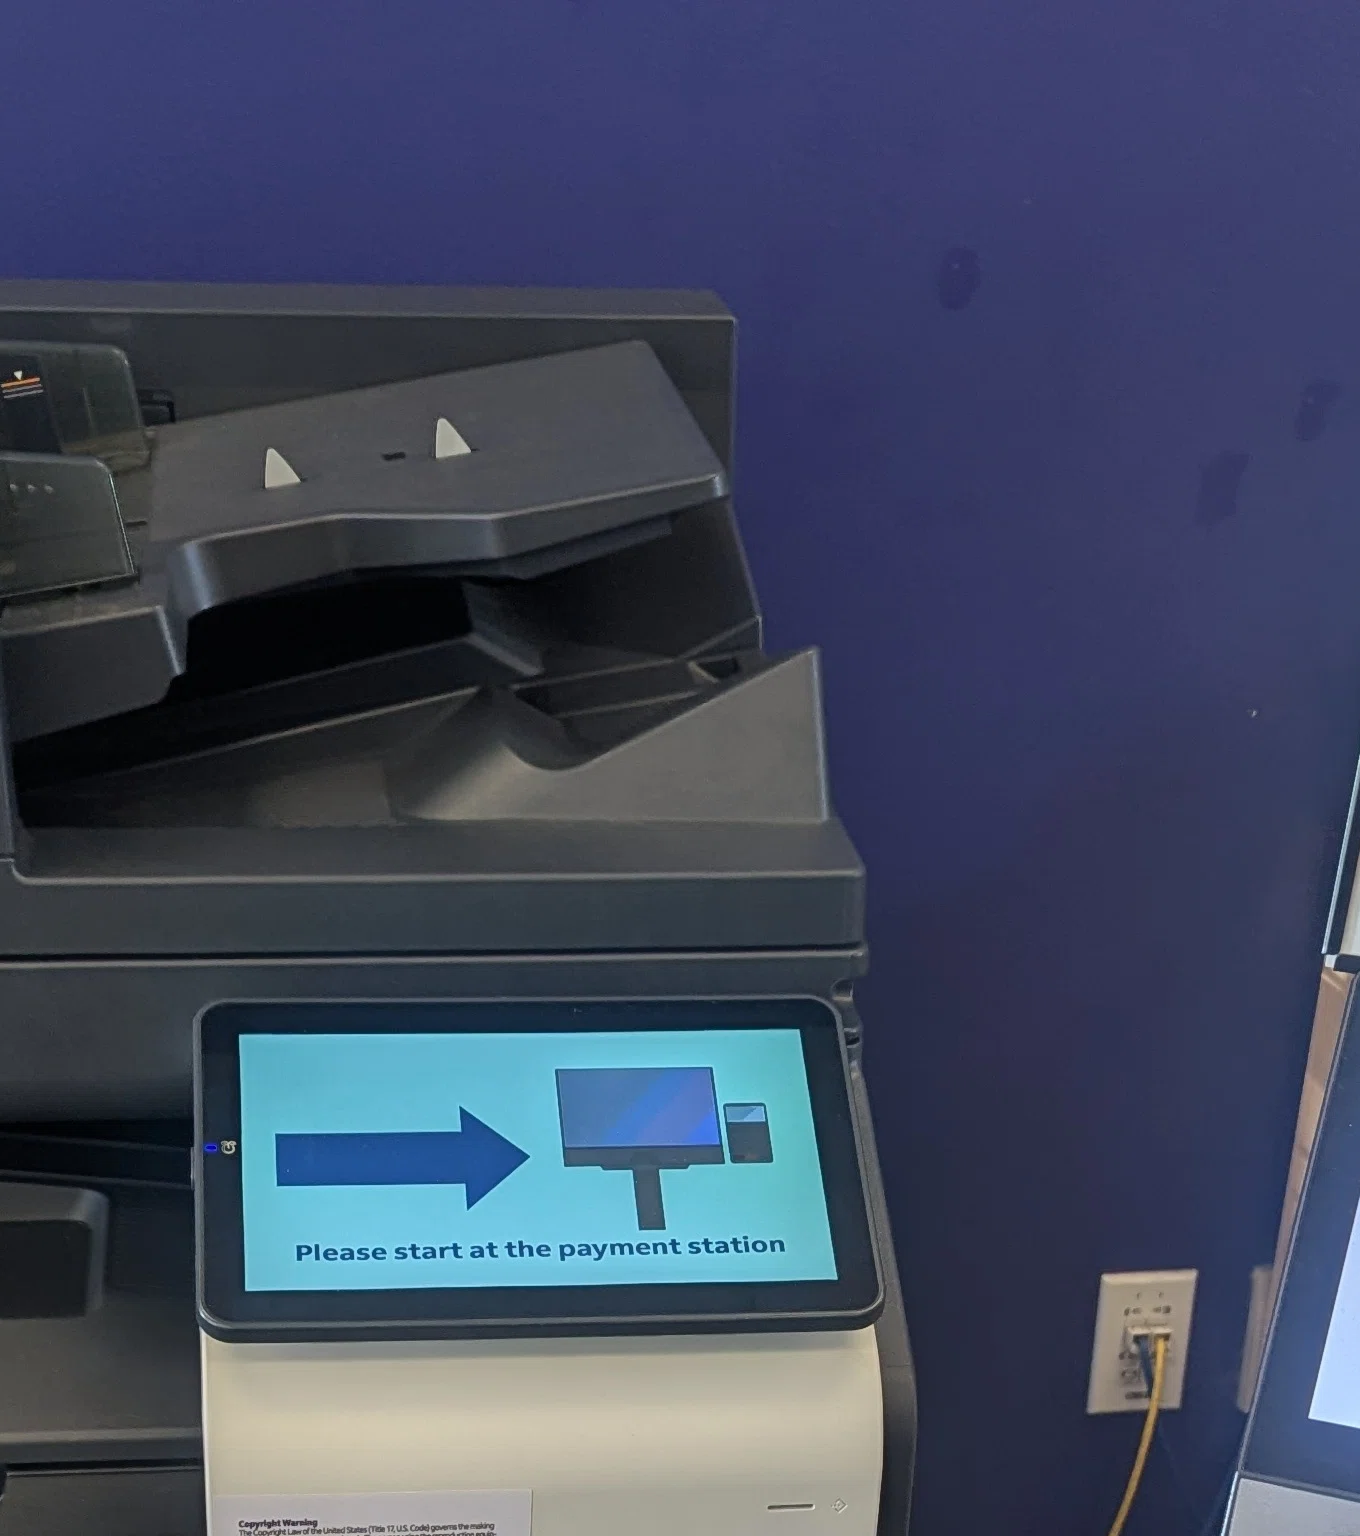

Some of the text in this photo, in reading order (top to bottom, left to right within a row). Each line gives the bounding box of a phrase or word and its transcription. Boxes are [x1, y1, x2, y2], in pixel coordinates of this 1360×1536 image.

[295, 1235, 785, 1261] Please start at the payment station
[282, 1517, 319, 1529] Warning
